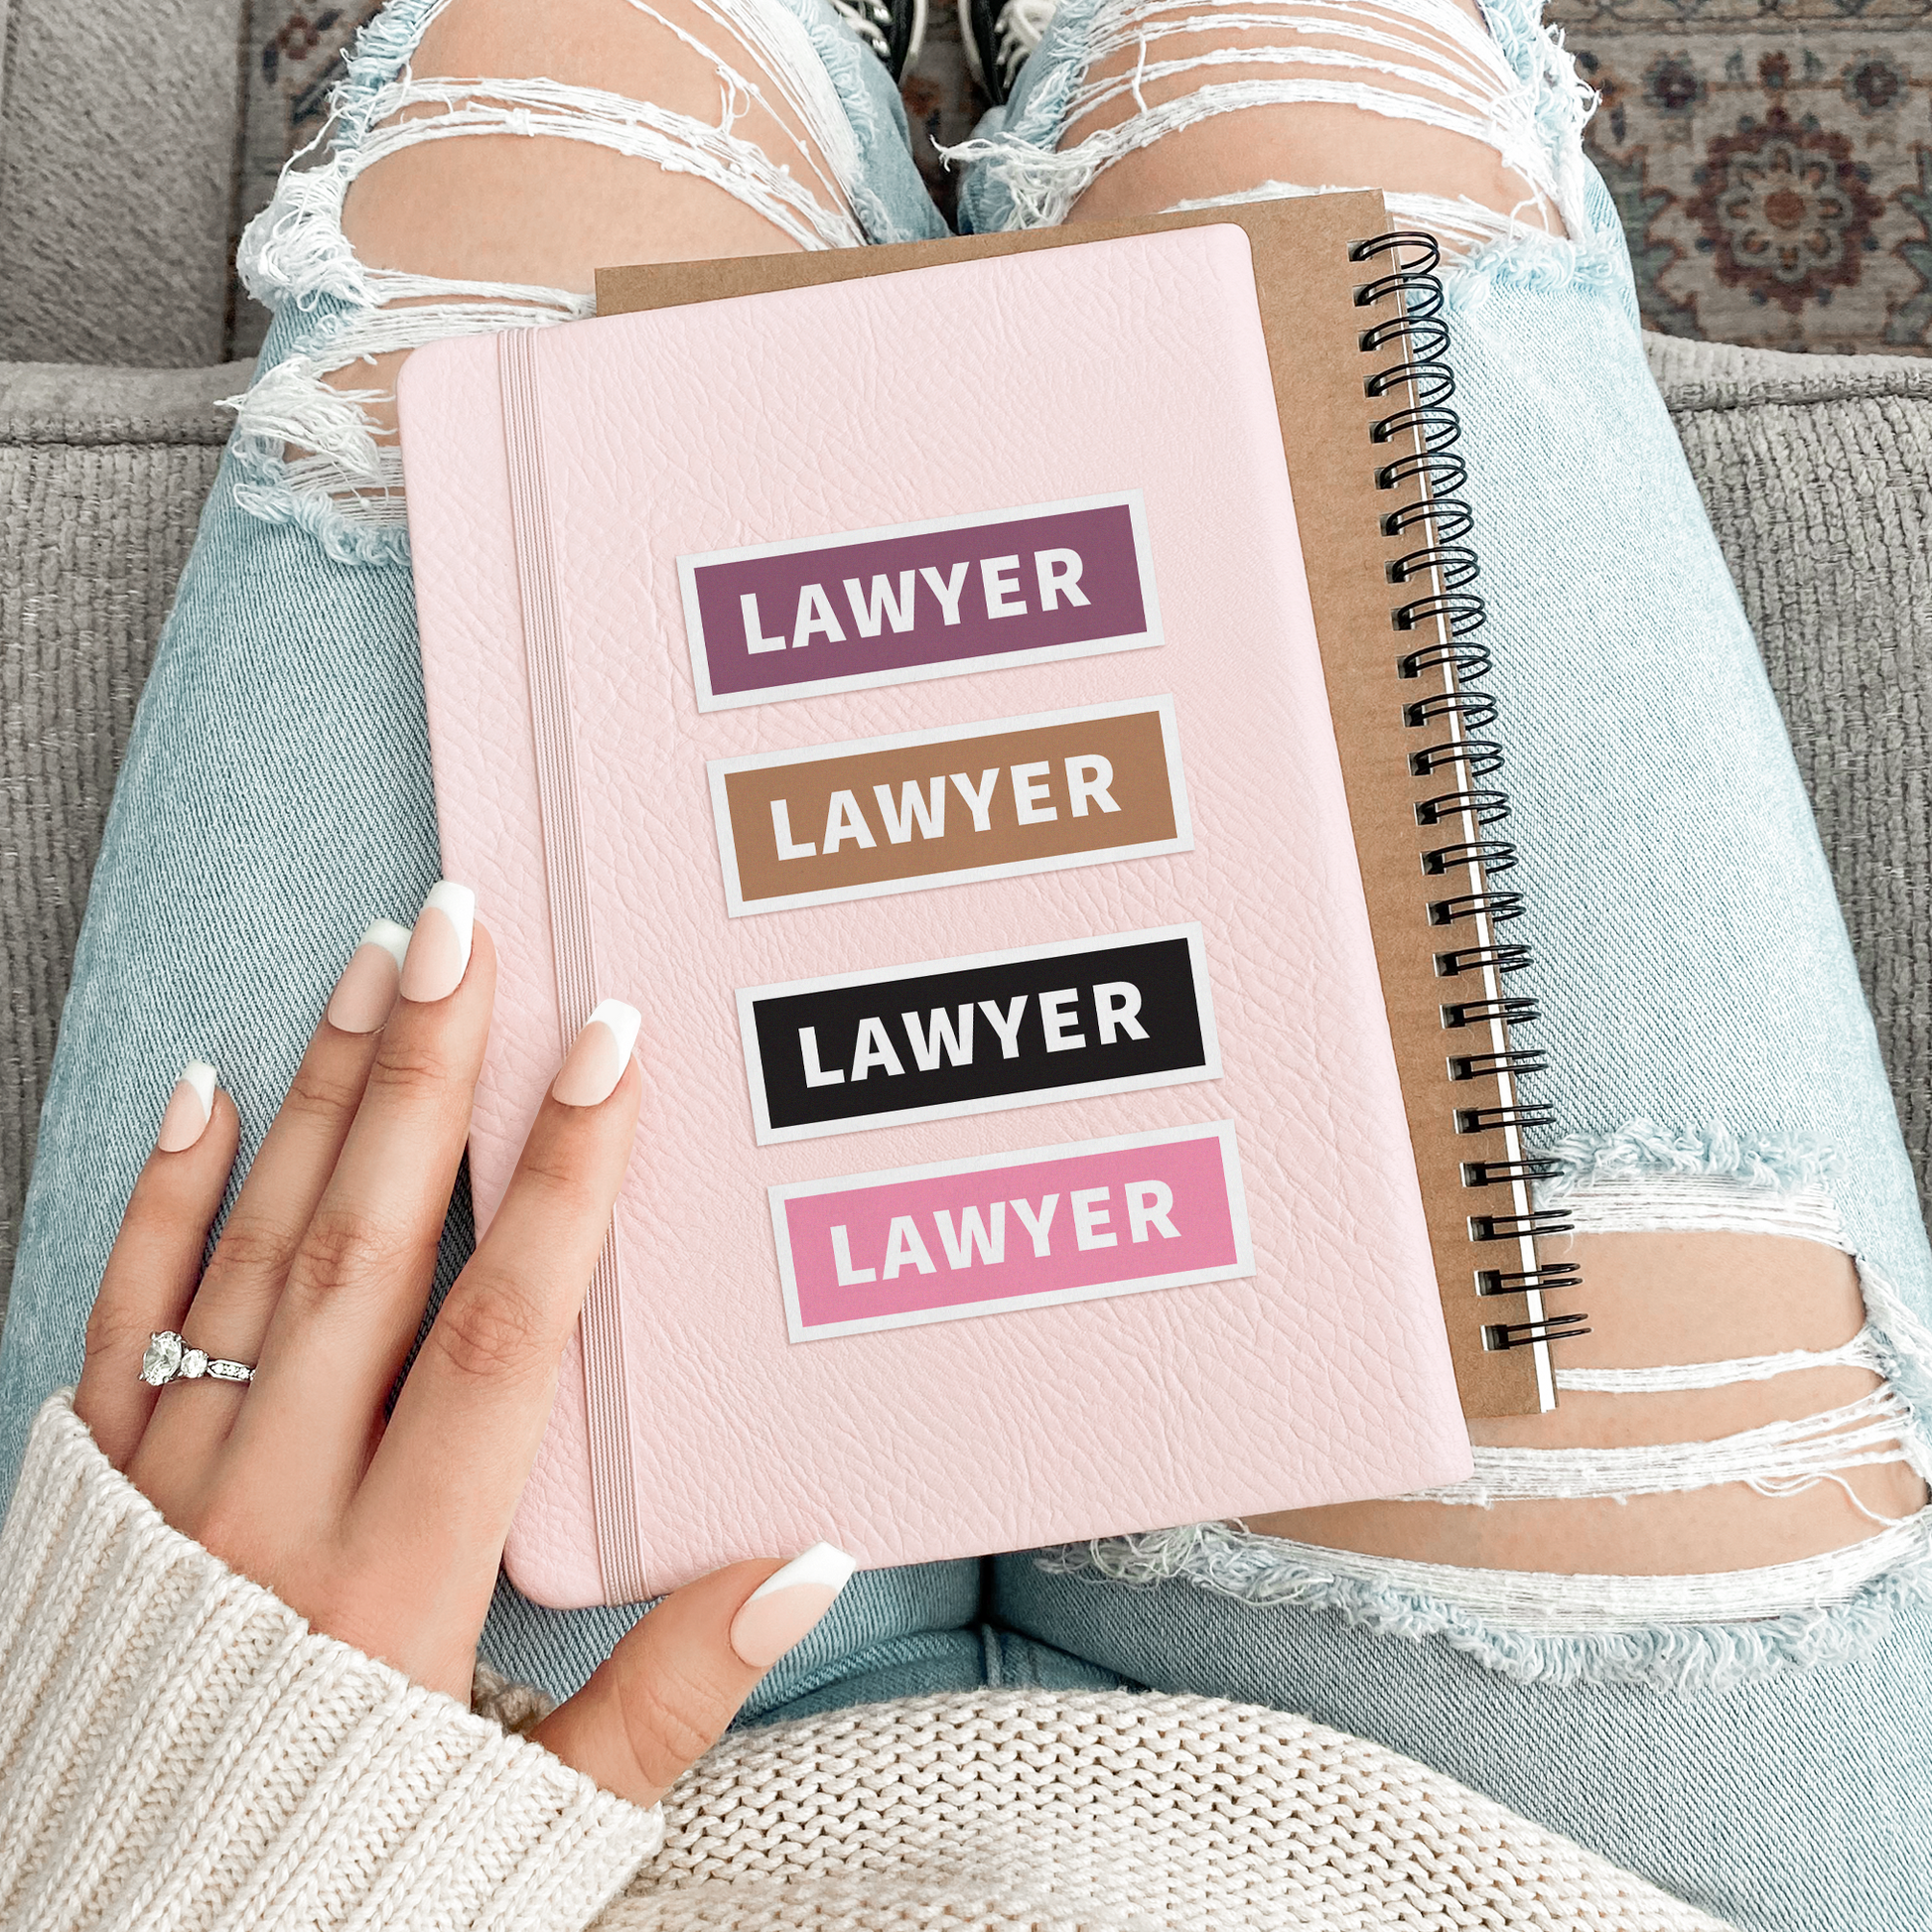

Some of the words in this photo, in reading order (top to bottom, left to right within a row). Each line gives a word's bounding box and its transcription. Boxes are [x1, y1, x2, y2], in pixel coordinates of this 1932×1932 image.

[740, 548, 1091, 655] LAWYER
[770, 754, 1122, 862] LAWYER
[798, 981, 1150, 1088] LAWYER
[829, 1179, 1182, 1287] LAWYER
